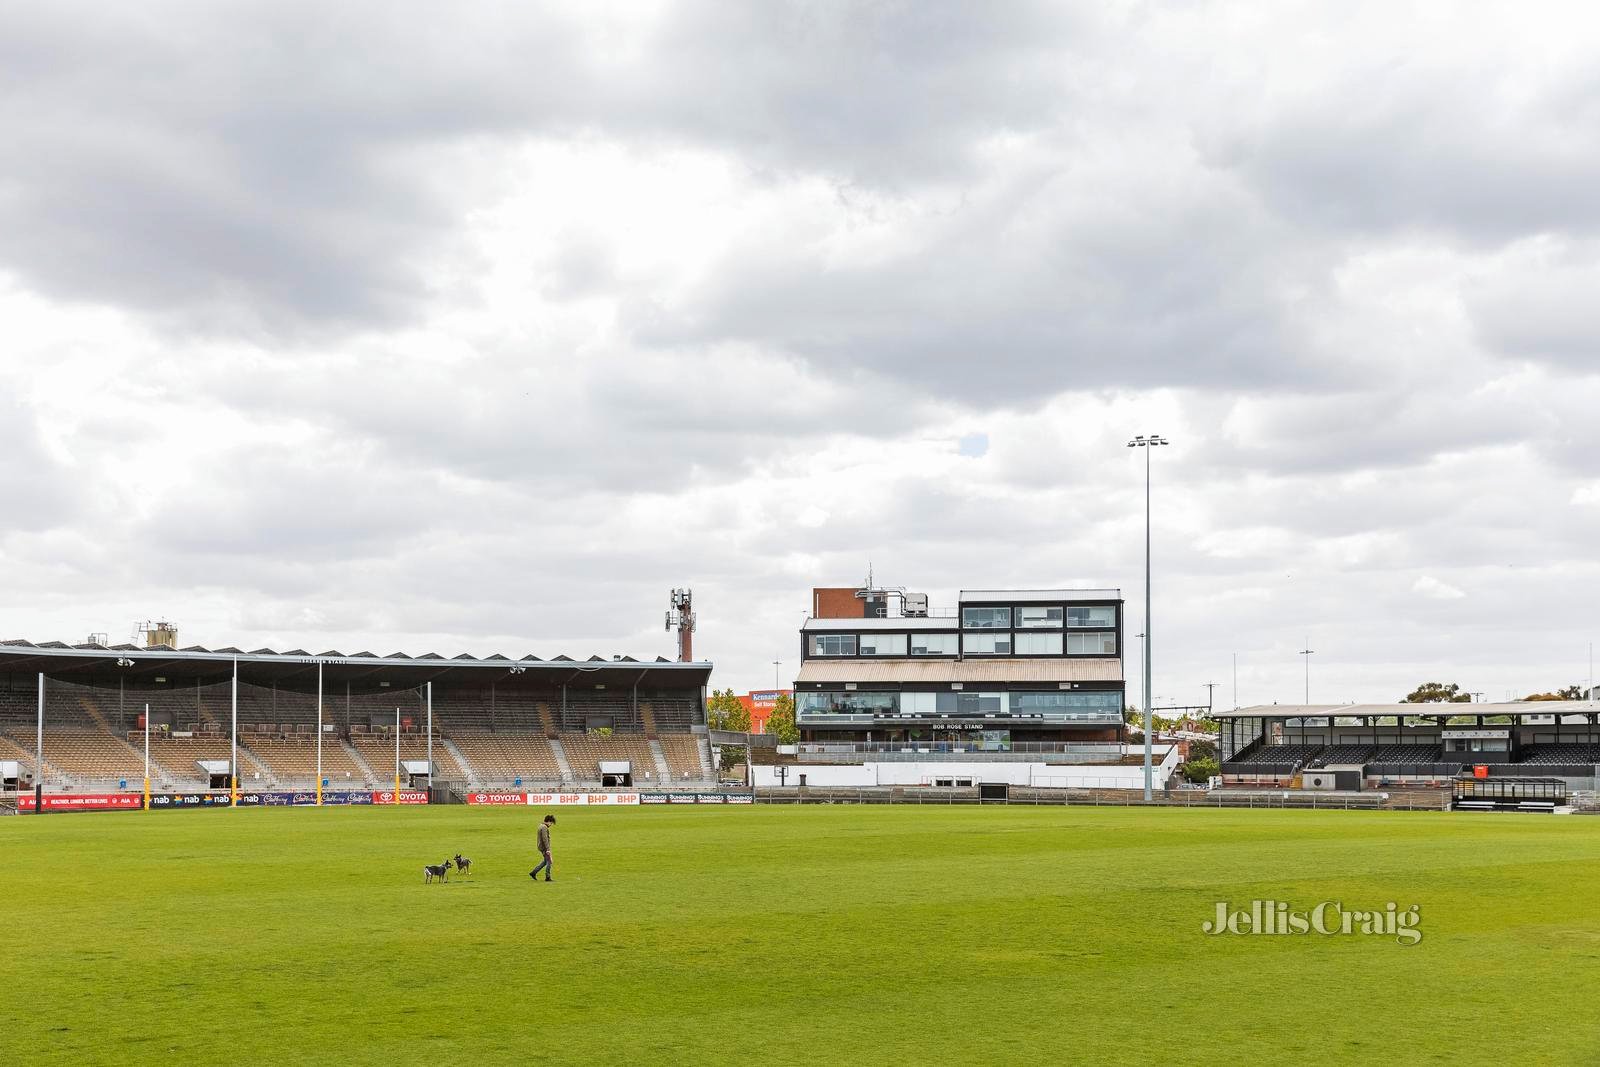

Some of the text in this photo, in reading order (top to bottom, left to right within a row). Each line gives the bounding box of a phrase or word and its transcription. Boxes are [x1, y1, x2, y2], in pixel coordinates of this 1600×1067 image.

[153, 796, 170, 804] nab
[184, 796, 200, 804] nab
[214, 795, 230, 803] nab
[243, 795, 259, 803] nab
[532, 795, 553, 803] BHP
[559, 795, 580, 803] BHP
[587, 795, 608, 803] BHP
[617, 795, 637, 803] BHP
